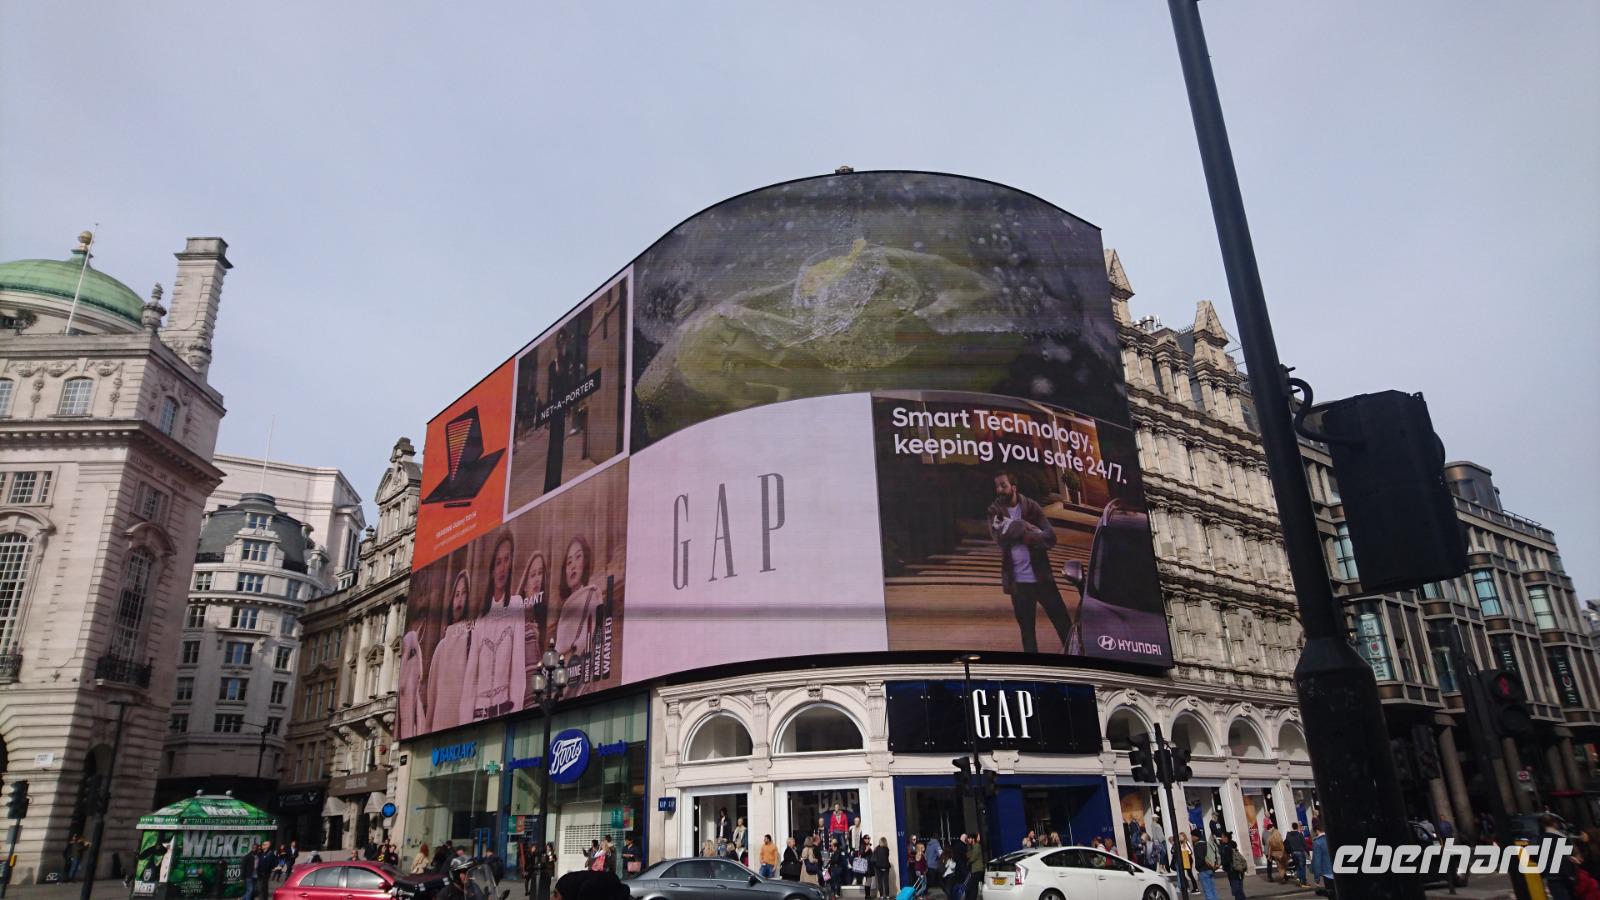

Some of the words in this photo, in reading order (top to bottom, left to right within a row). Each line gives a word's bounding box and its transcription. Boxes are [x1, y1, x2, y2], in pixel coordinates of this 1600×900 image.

[541, 378, 594, 420] NET-A-PORTER
[892, 407, 970, 428] Smart
[974, 409, 1094, 453] Technology,
[894, 434, 993, 462] keeping
[998, 442, 1039, 463] you
[1044, 450, 1084, 472] safe
[1086, 456, 1128, 484] 24/7.
[673, 472, 785, 590] GAP
[602, 616, 613, 674] WANTED
[1118, 638, 1162, 656] HYUNDAI
[972, 688, 1033, 739] GAP
[549, 737, 583, 776] Boots
